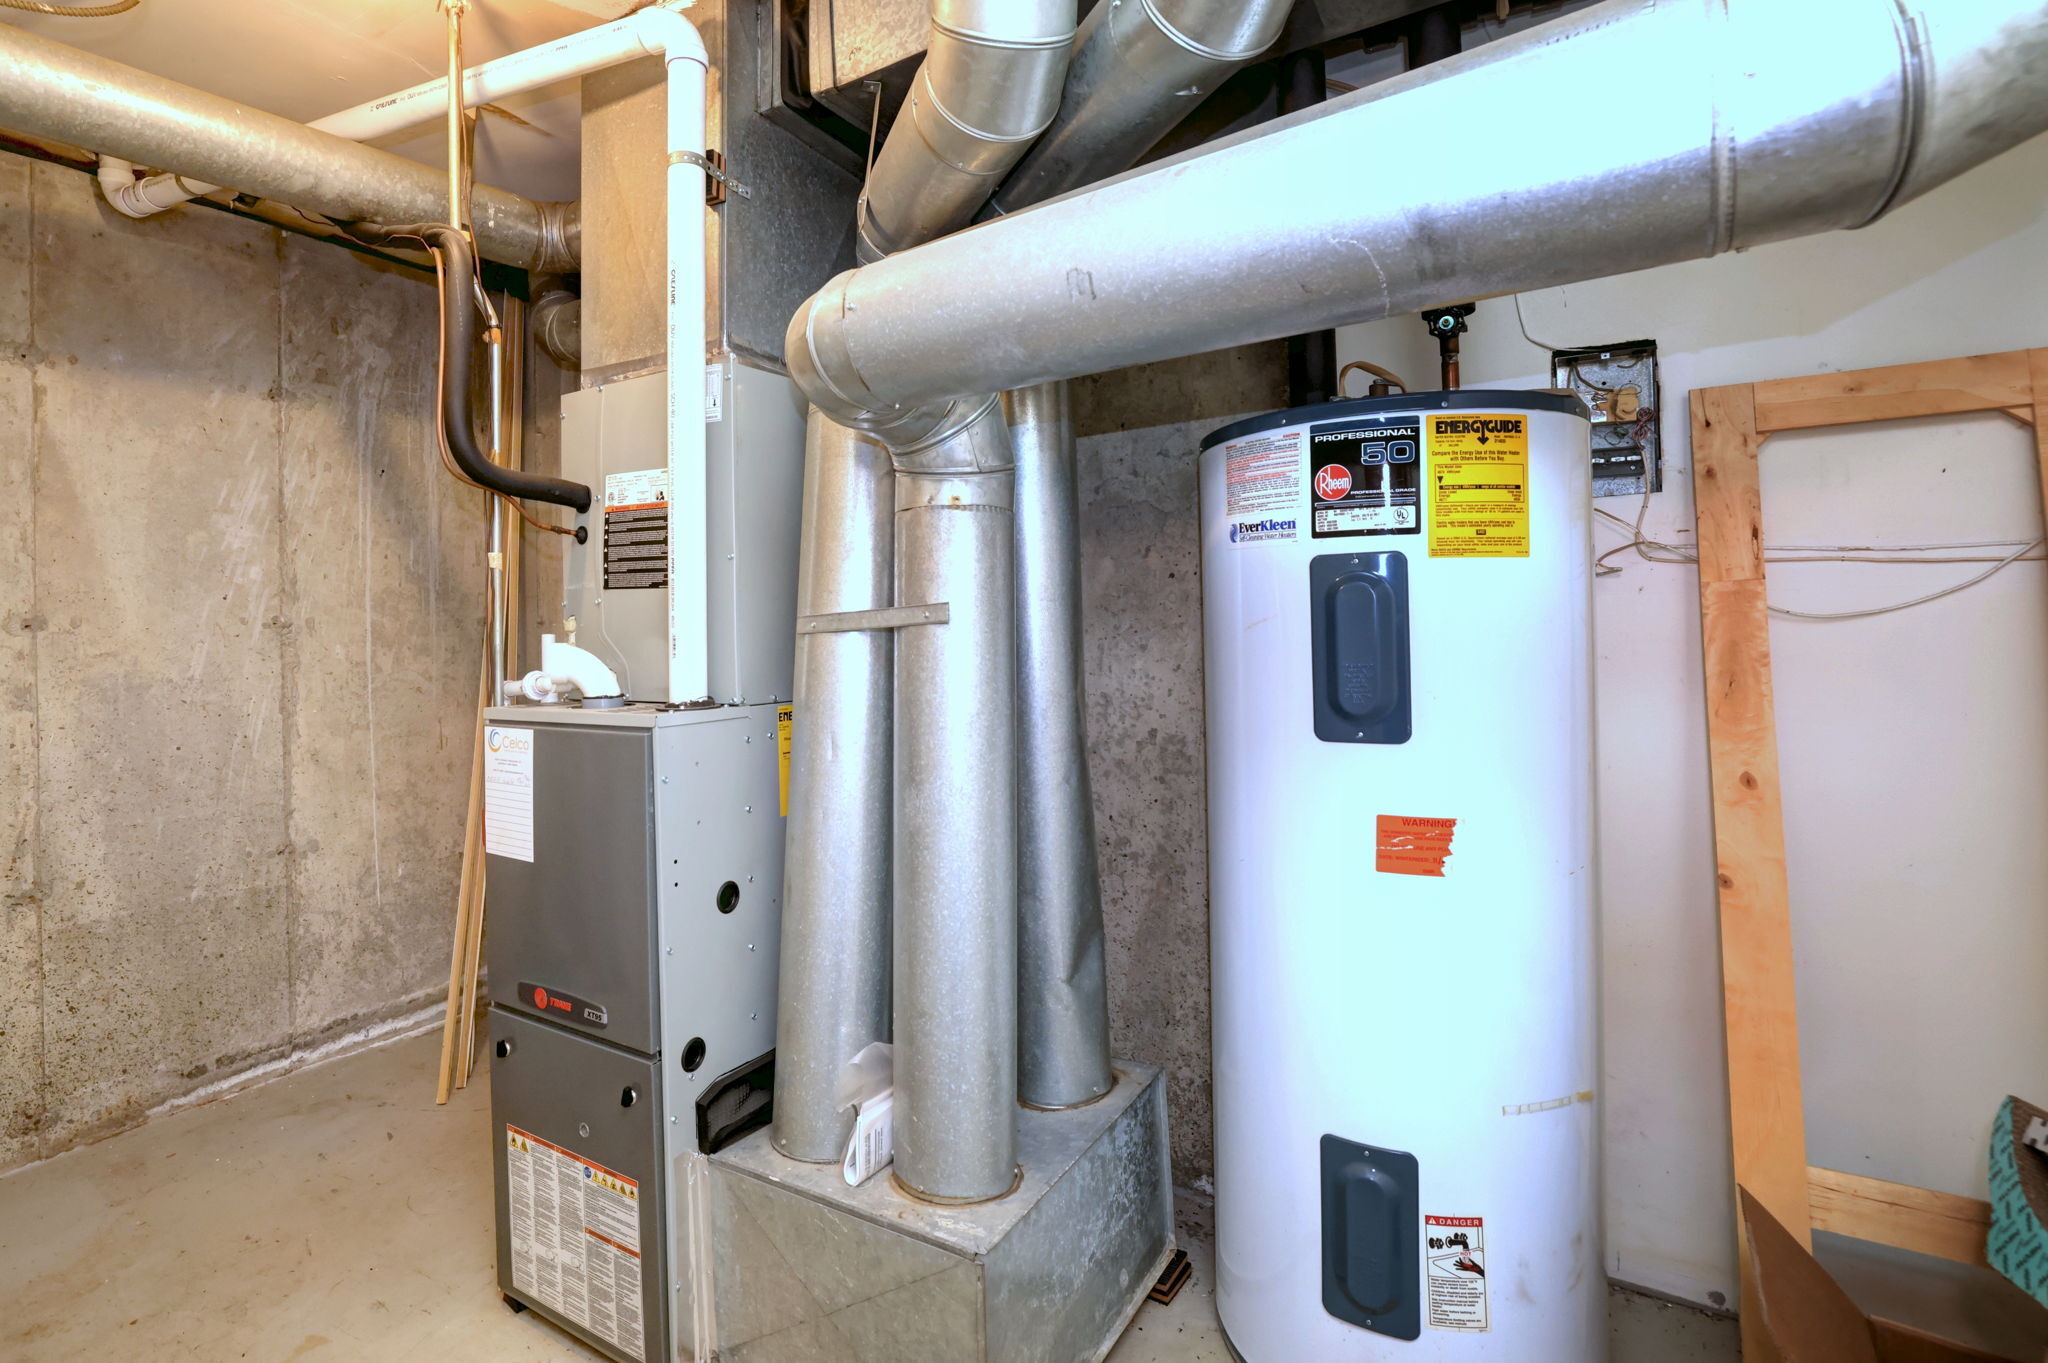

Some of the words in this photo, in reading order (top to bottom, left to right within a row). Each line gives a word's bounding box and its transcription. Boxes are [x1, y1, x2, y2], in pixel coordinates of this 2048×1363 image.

[1435, 419, 1522, 435] ENERGYGUIDE
[1314, 428, 1416, 443] PROFESSIONAL
[1361, 439, 1416, 466] 50
[1319, 466, 1350, 496] Rheem
[1238, 519, 1297, 534] EverKleen
[502, 735, 529, 751] Celco
[587, 1010, 602, 1022] XT95
[1439, 1218, 1480, 1227] DANGER
